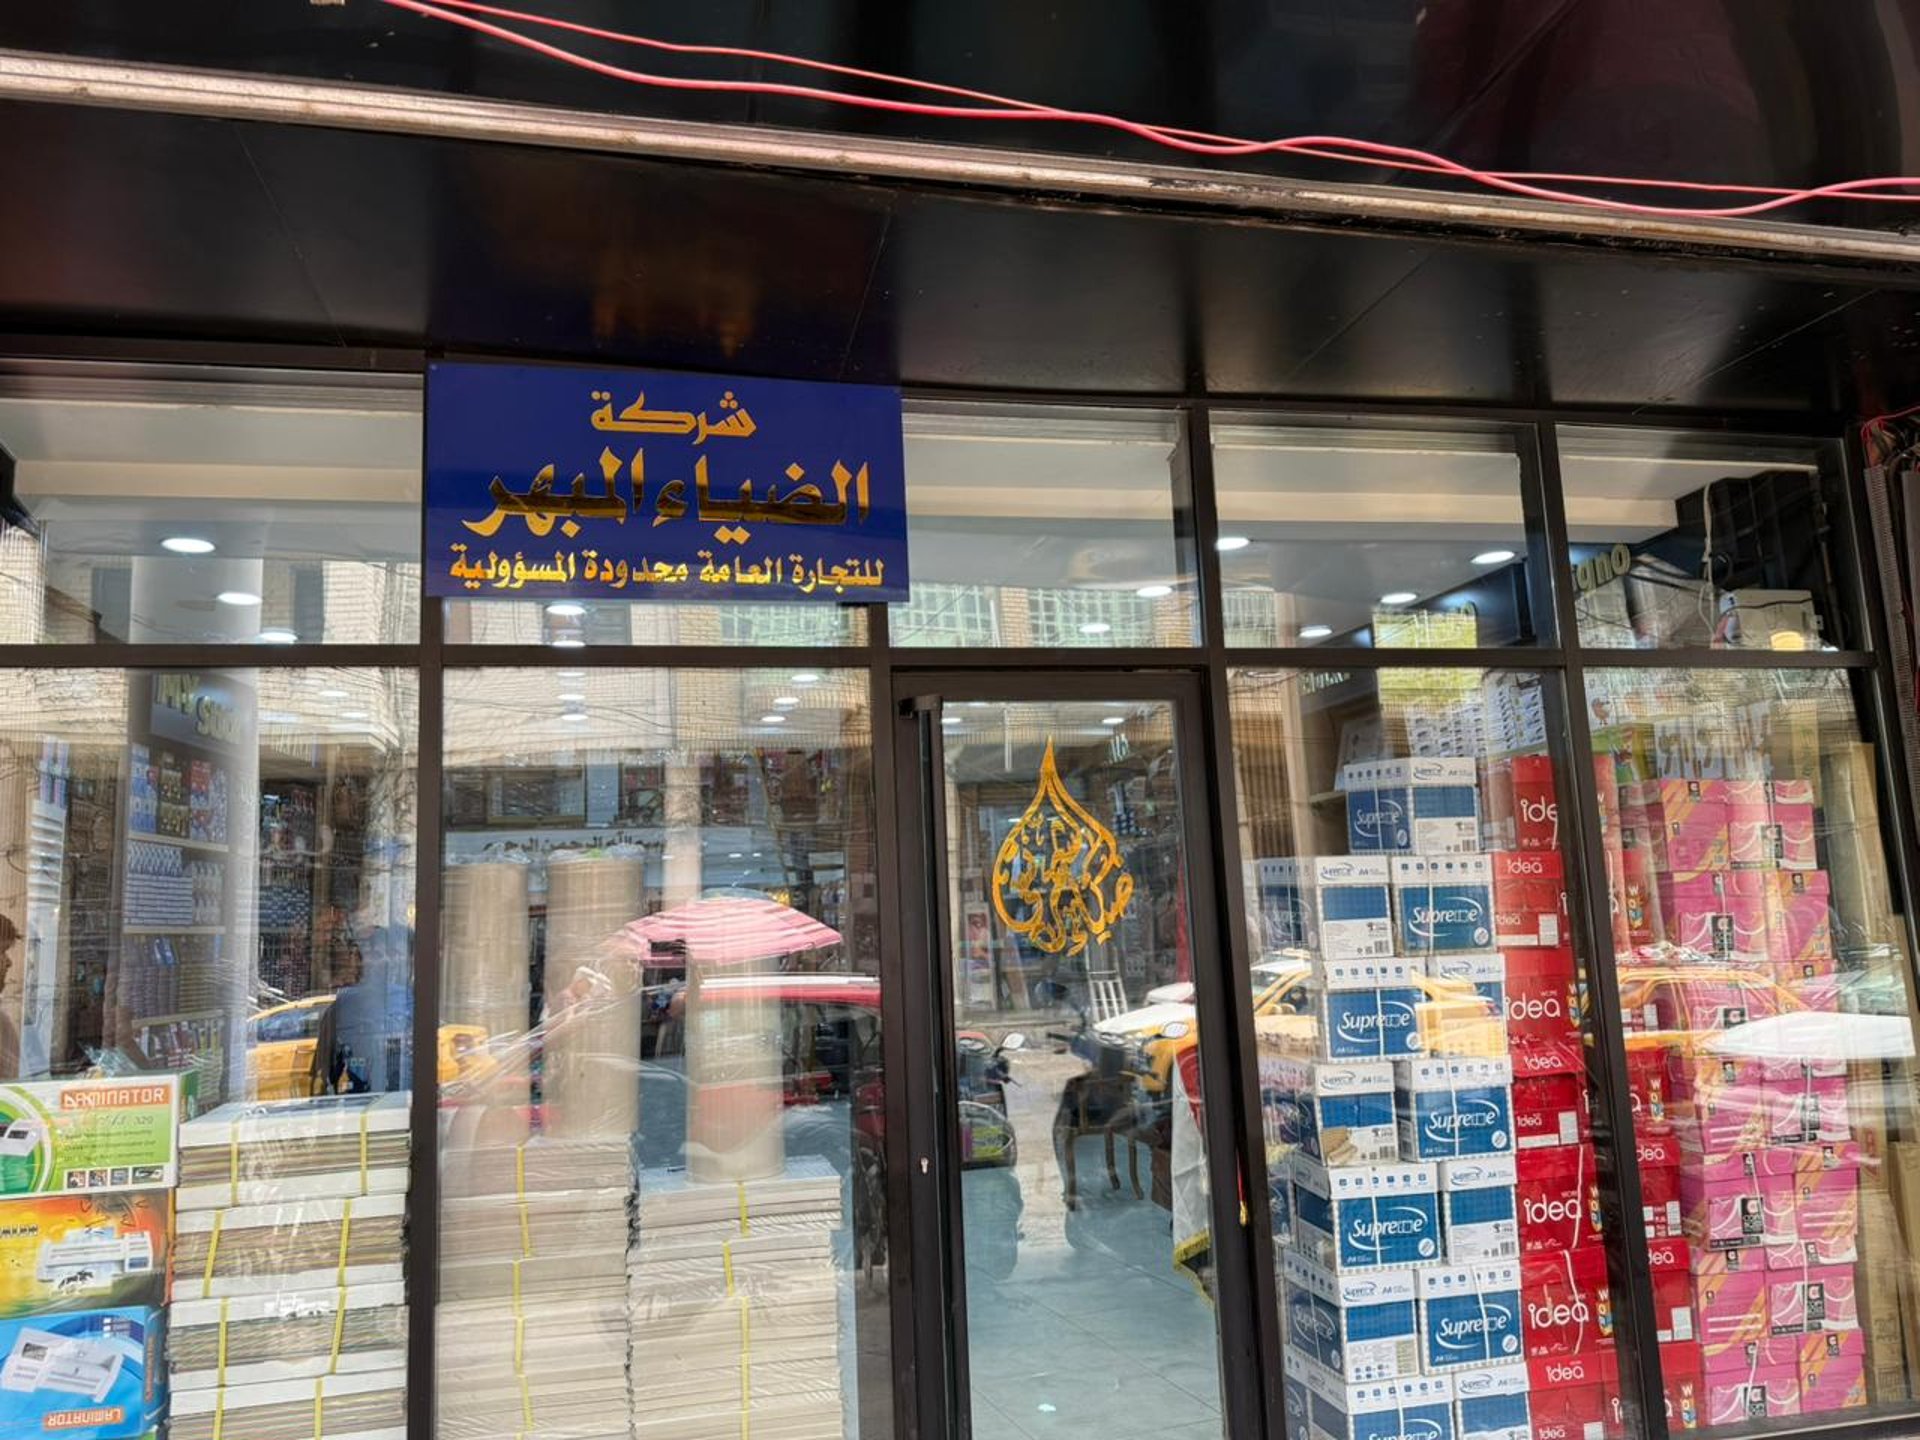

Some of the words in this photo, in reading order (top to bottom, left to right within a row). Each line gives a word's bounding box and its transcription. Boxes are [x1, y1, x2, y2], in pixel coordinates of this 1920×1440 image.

[590, 390, 757, 445] شركة
[462, 446, 645, 538] المبهر
[653, 454, 870, 545] الضياء
[449, 543, 575, 589] المسؤولية
[583, 549, 690, 589] محدودة
[698, 549, 783, 585] العامة
[790, 554, 885, 595] للتجارة
[1506, 857, 1543, 874] idea
[1412, 906, 1478, 926] Supreme
[1504, 992, 1561, 1021] idea
[1341, 1012, 1410, 1034] Supreme
[1523, 1053, 1563, 1070] idea
[1429, 1111, 1496, 1134] Supreme
[1523, 1193, 1582, 1225] idea
[1353, 1218, 1423, 1241] Supreme
[1439, 1315, 1507, 1340] Supreme
[1528, 1296, 1589, 1330] idea
[1546, 1363, 1585, 1383] idea
